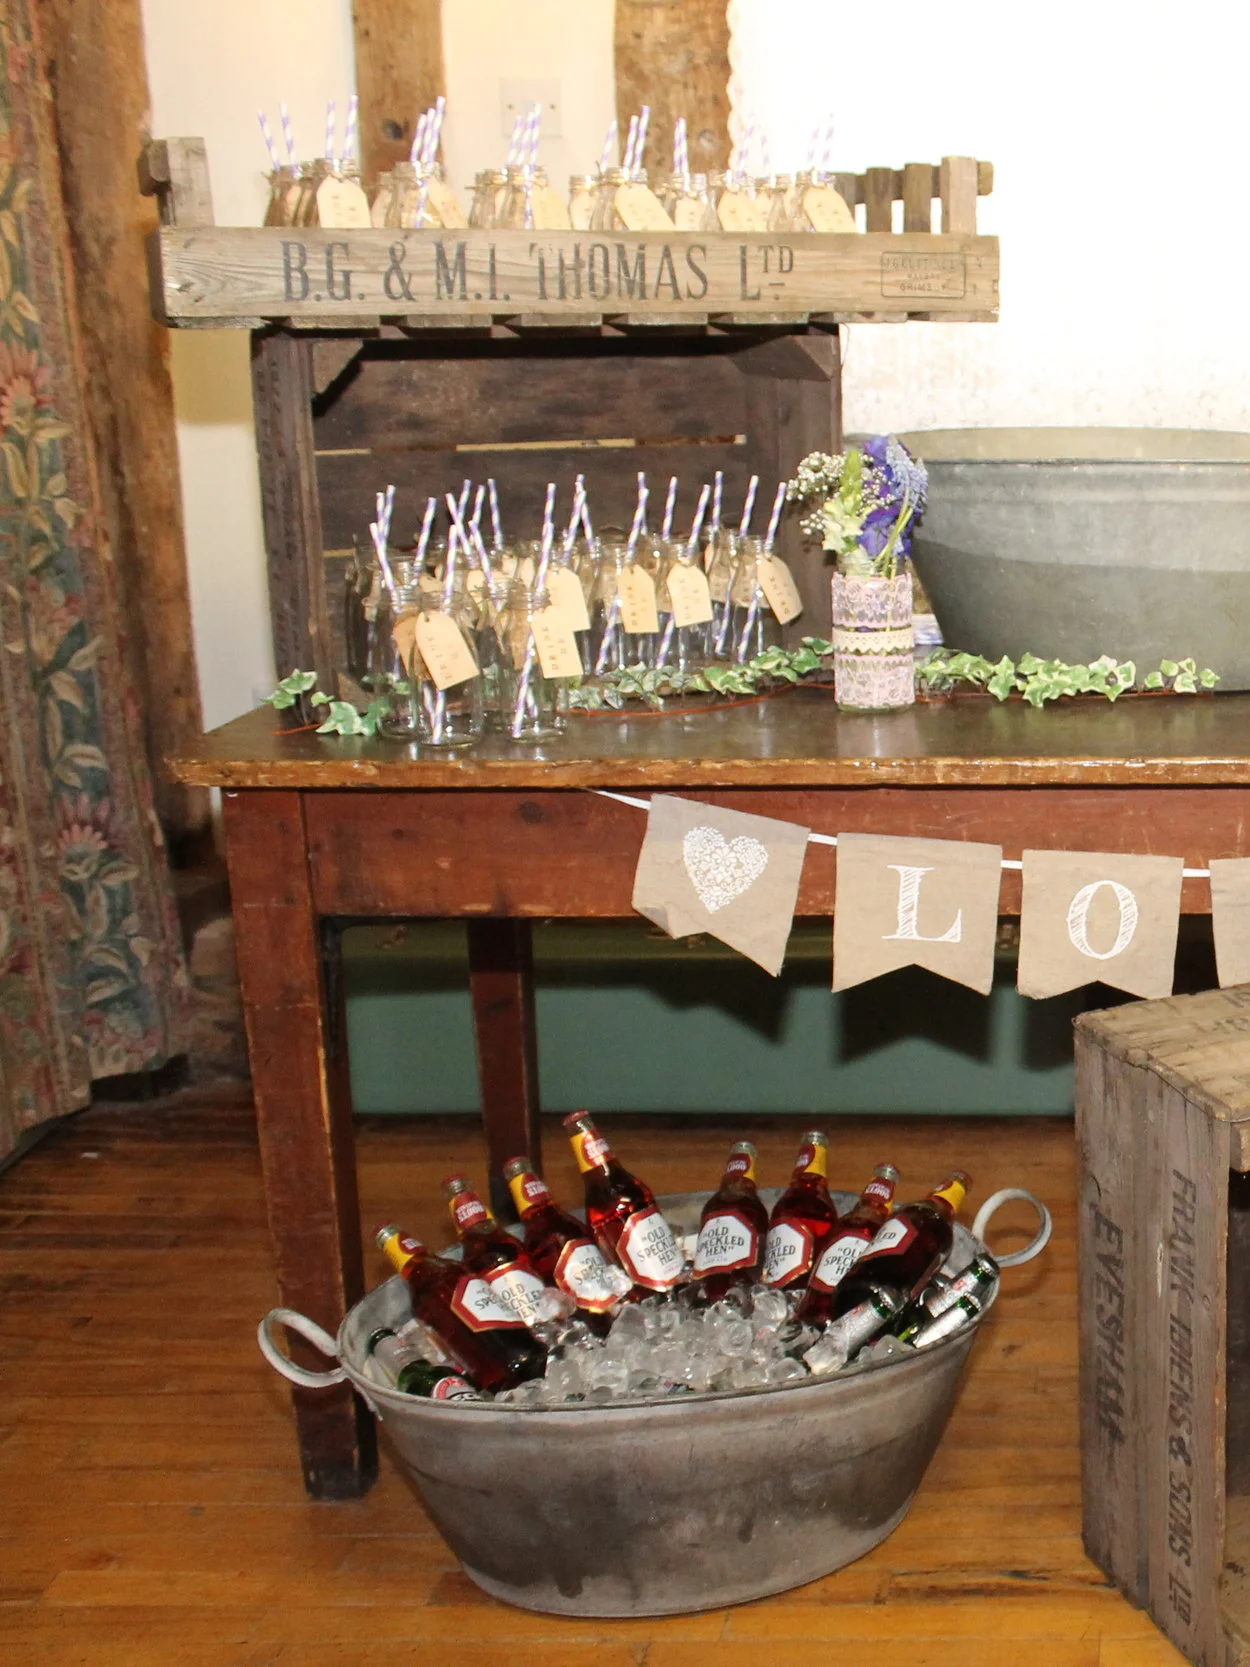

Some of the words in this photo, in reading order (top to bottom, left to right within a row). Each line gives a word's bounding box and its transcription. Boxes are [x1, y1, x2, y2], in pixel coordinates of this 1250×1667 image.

[280, 240, 366, 302] B.G.
[383, 240, 417, 302] &
[529, 241, 709, 301] THOMAS
[1169, 1169, 1197, 1304] FRANK
[1089, 1202, 1126, 1445] EVESHAM
[1168, 1435, 1193, 1468] &
[1168, 1471, 1193, 1567] SONS
